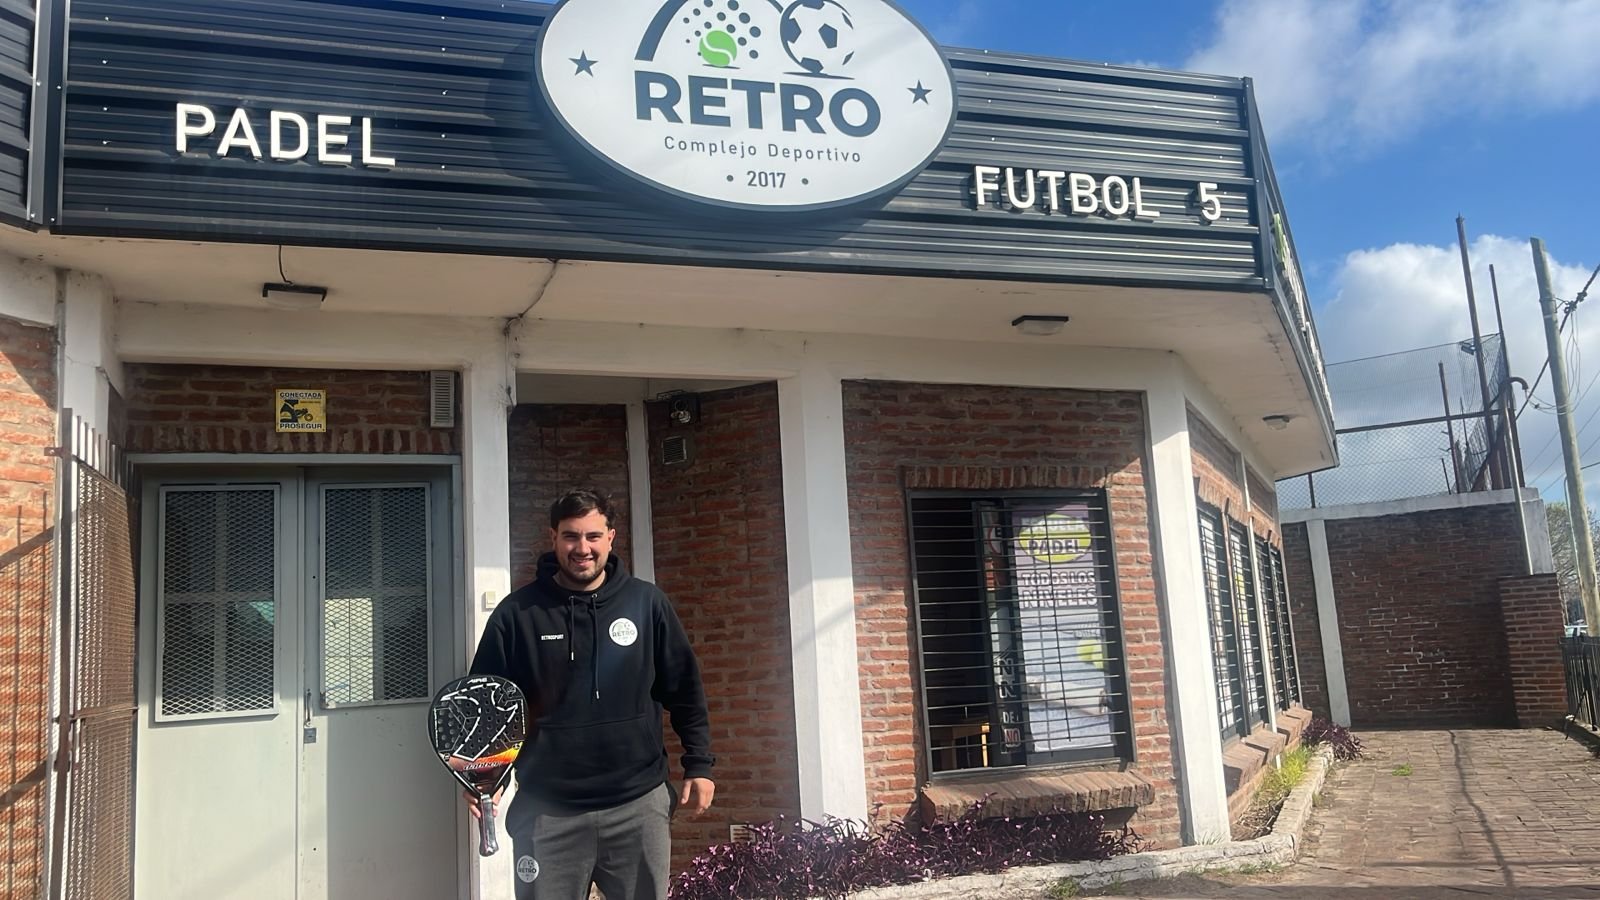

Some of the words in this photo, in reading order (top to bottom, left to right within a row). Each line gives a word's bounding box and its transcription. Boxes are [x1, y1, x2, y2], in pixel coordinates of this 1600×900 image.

[634, 70, 881, 138] RETRO
[176, 103, 396, 167] PADEL
[664, 136, 757, 159] Complejo
[768, 143, 861, 163] Deportivo
[746, 170, 786, 189] 2017
[974, 165, 1160, 218] FUTBOL
[1197, 181, 1222, 221] 5
[1027, 539, 1082, 554] PADEL
[1069, 571, 1096, 584] LOS
